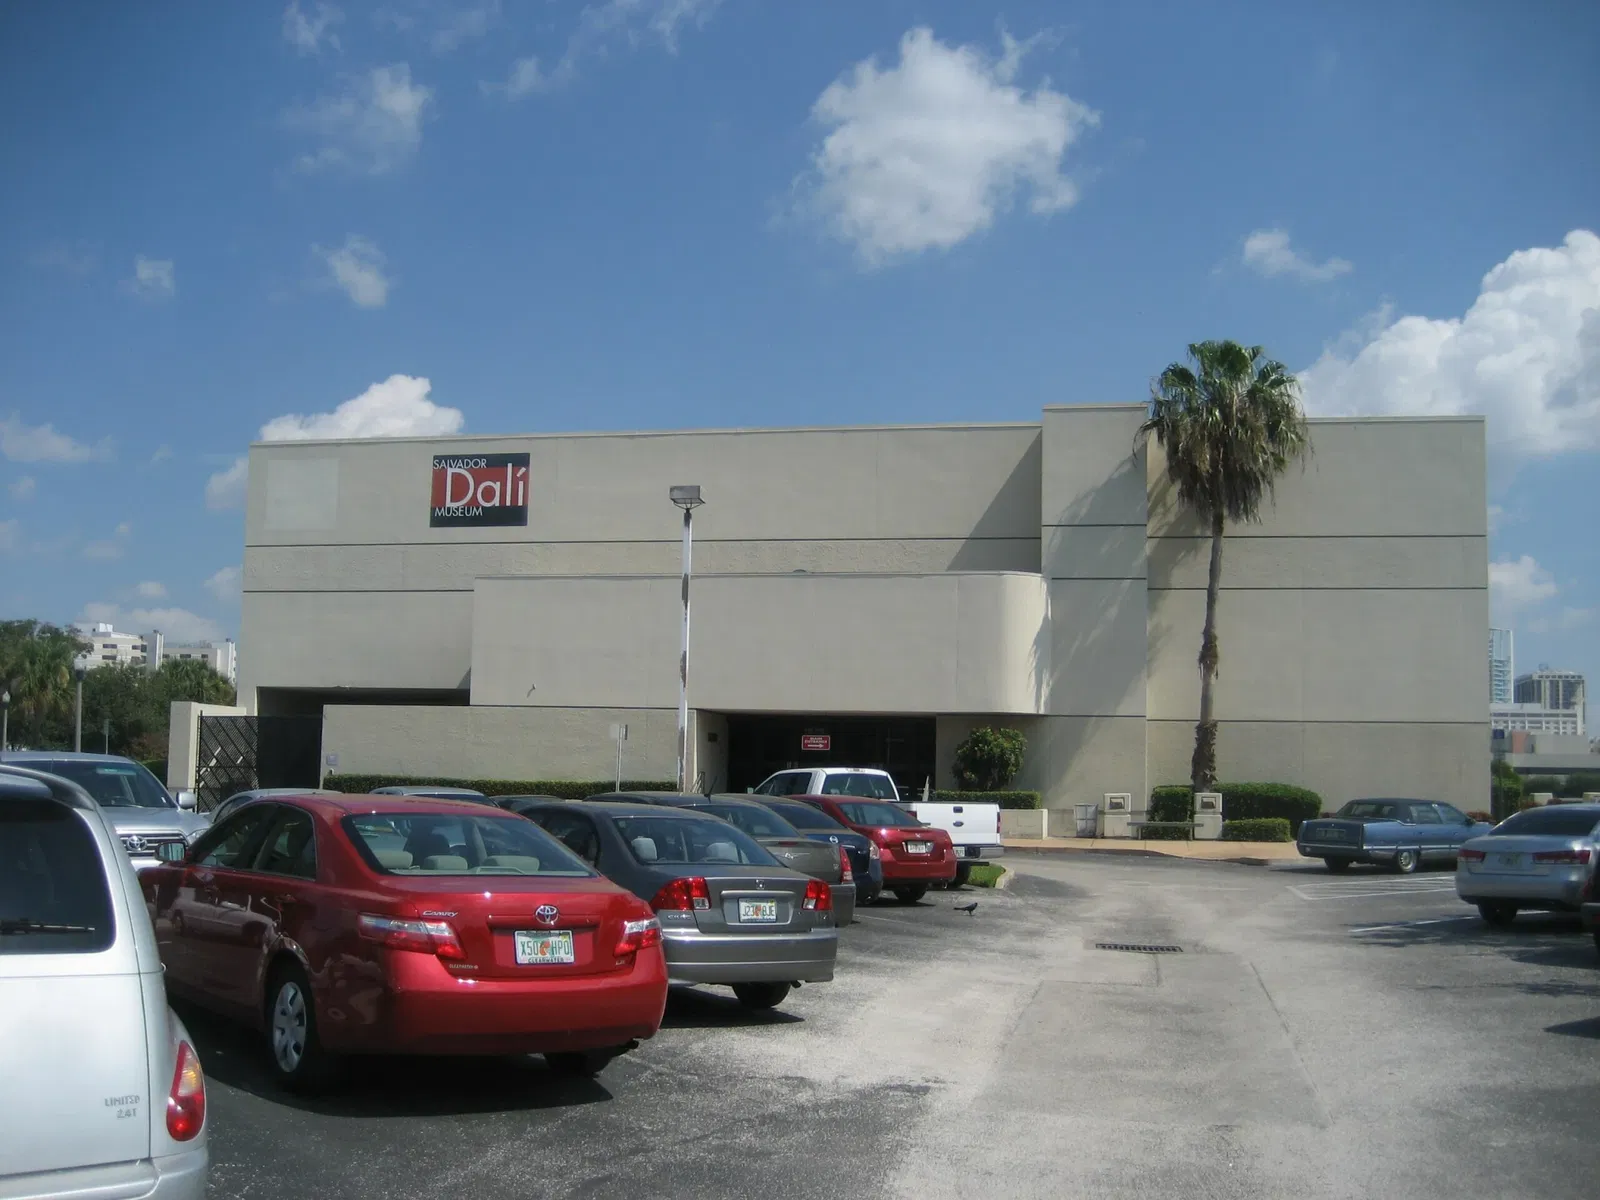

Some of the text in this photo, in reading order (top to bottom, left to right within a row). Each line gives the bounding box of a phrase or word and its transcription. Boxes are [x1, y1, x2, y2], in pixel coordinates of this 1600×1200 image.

[433, 458, 487, 469] SALVADOR
[446, 462, 527, 507] Dalí
[434, 506, 483, 517] MUSEUM
[527, 956, 565, 964] CLEARWATER
